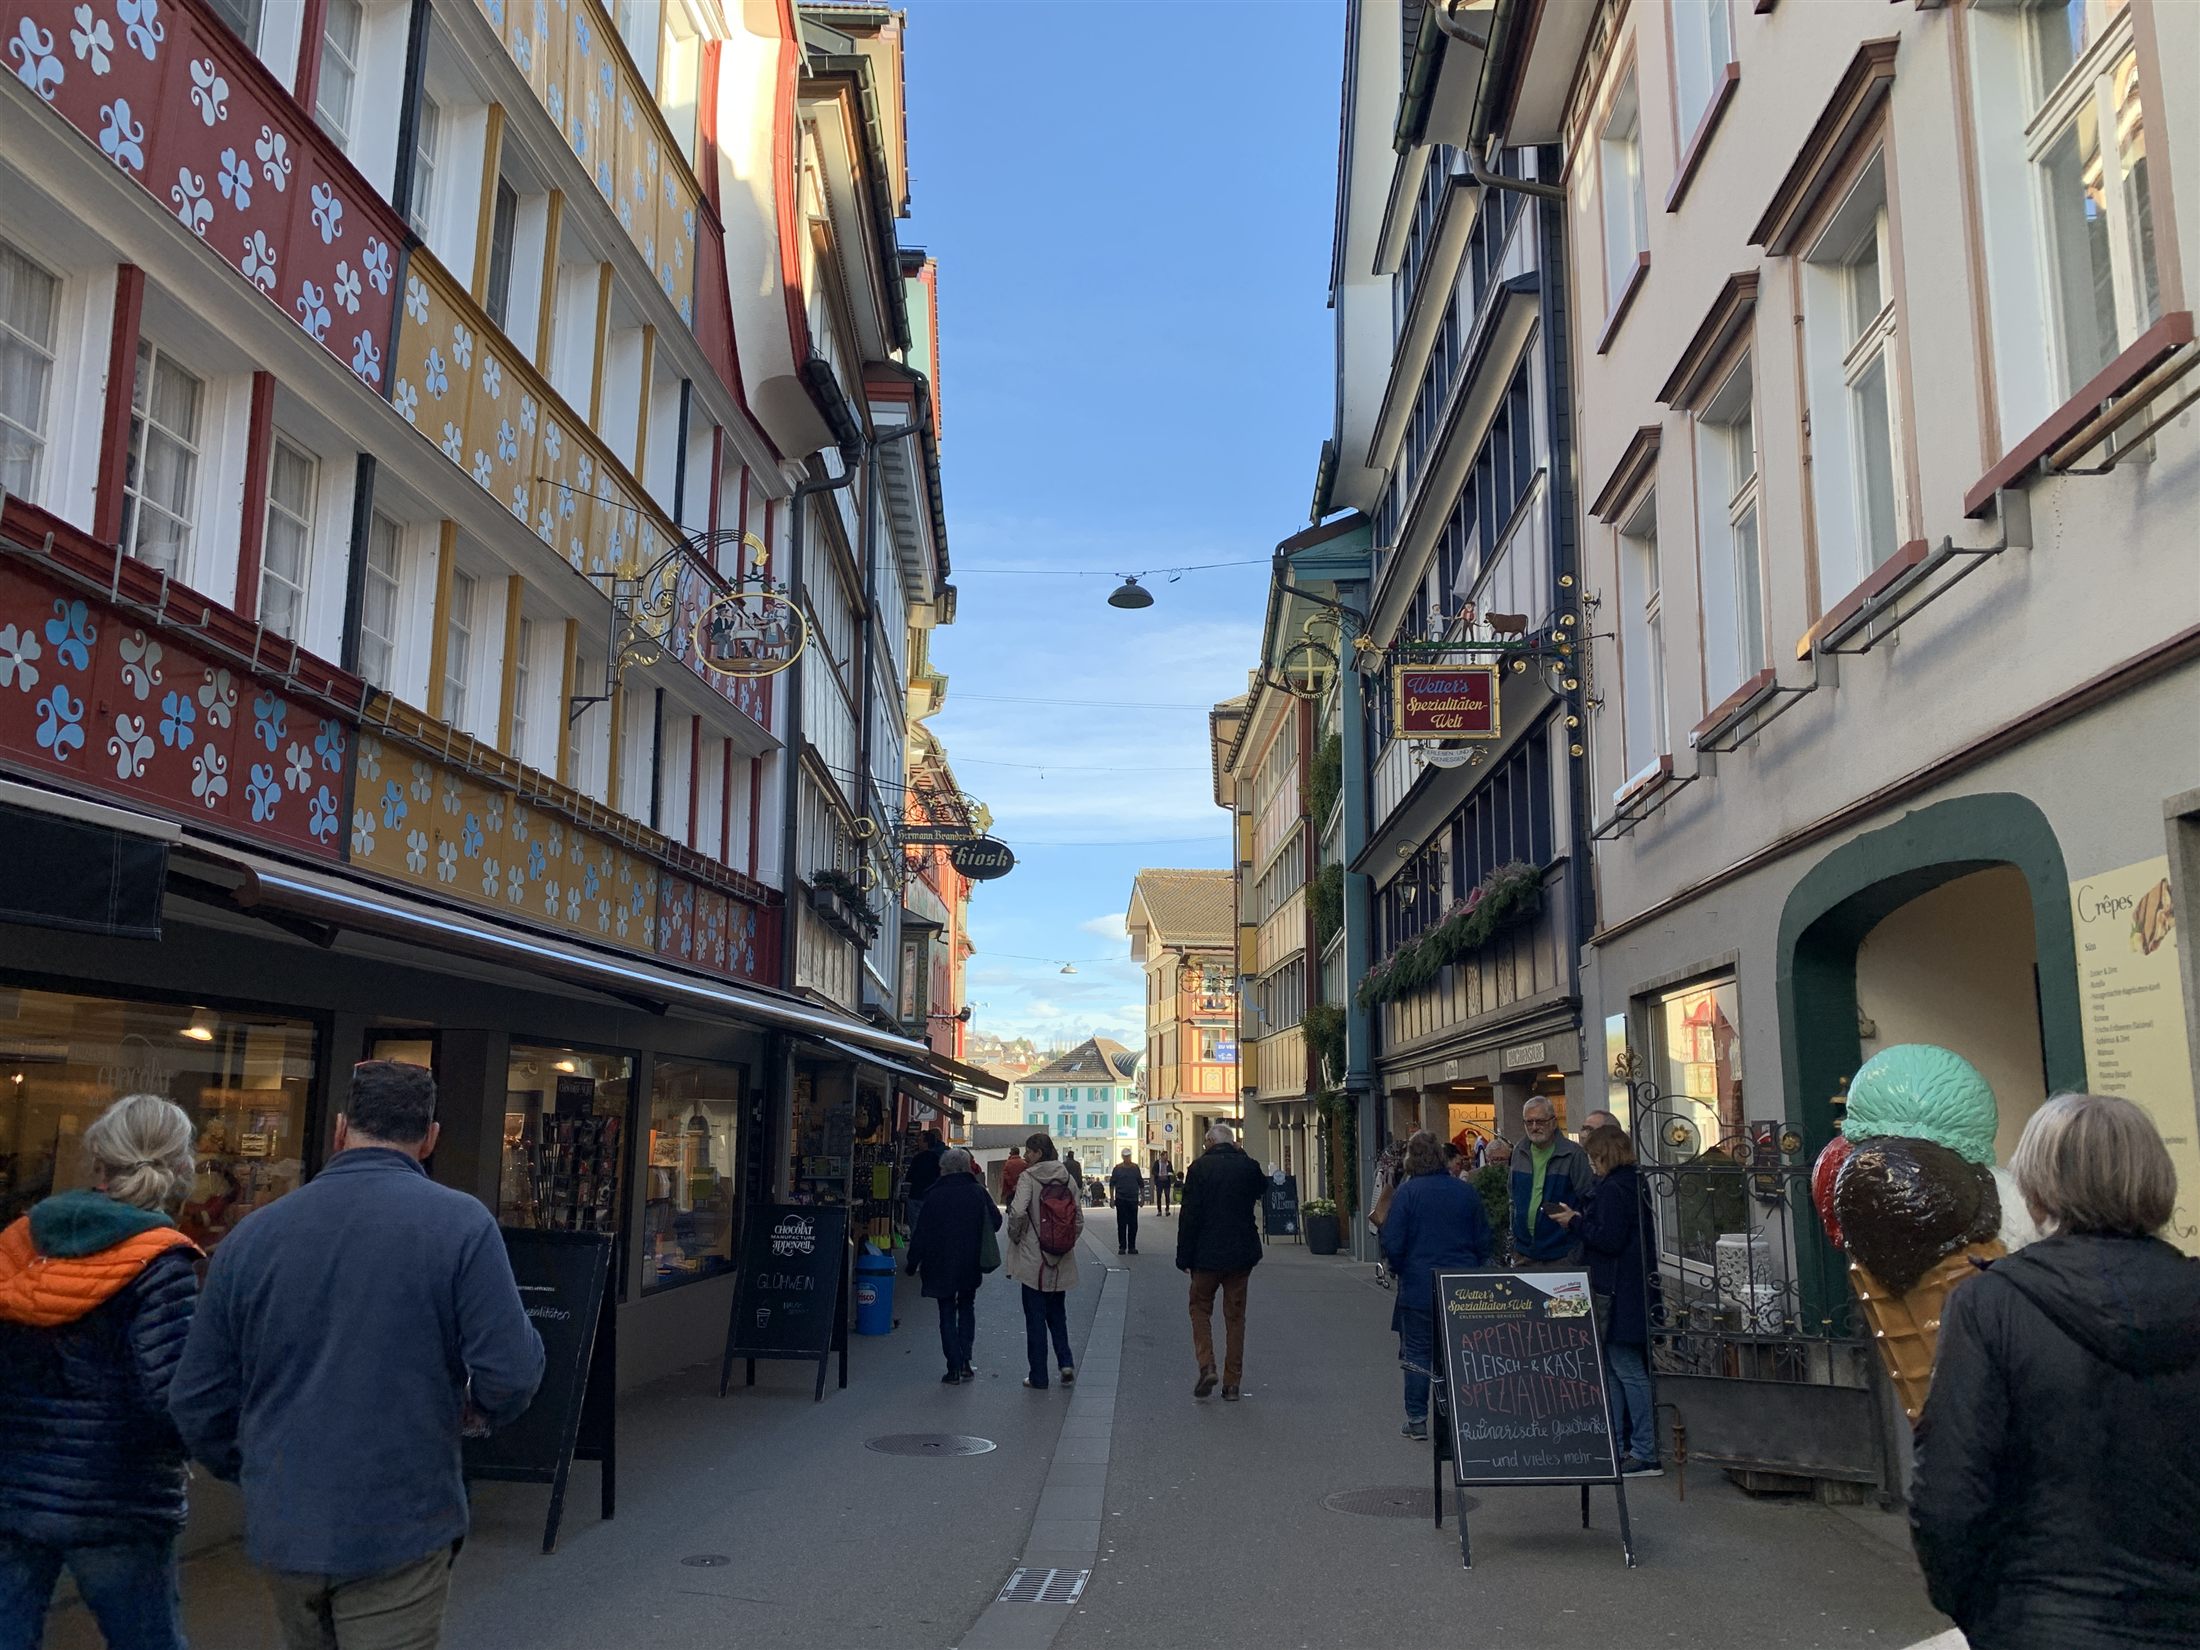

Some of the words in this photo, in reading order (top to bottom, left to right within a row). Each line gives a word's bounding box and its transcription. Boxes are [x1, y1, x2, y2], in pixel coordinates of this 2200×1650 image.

[1408, 677, 1470, 694] Wetter's
[1407, 697, 1488, 717] Spezialitäten-
[1431, 714, 1464, 729] Welt
[2078, 884, 2134, 922] Crêpes
[774, 1219, 815, 1235] CHOCOLAT
[1460, 1320, 1592, 1358] APPENZELLER
[1492, 1450, 1518, 1468] und
[1523, 1449, 1560, 1467] vieles
[1564, 1448, 1592, 1465] mehr
